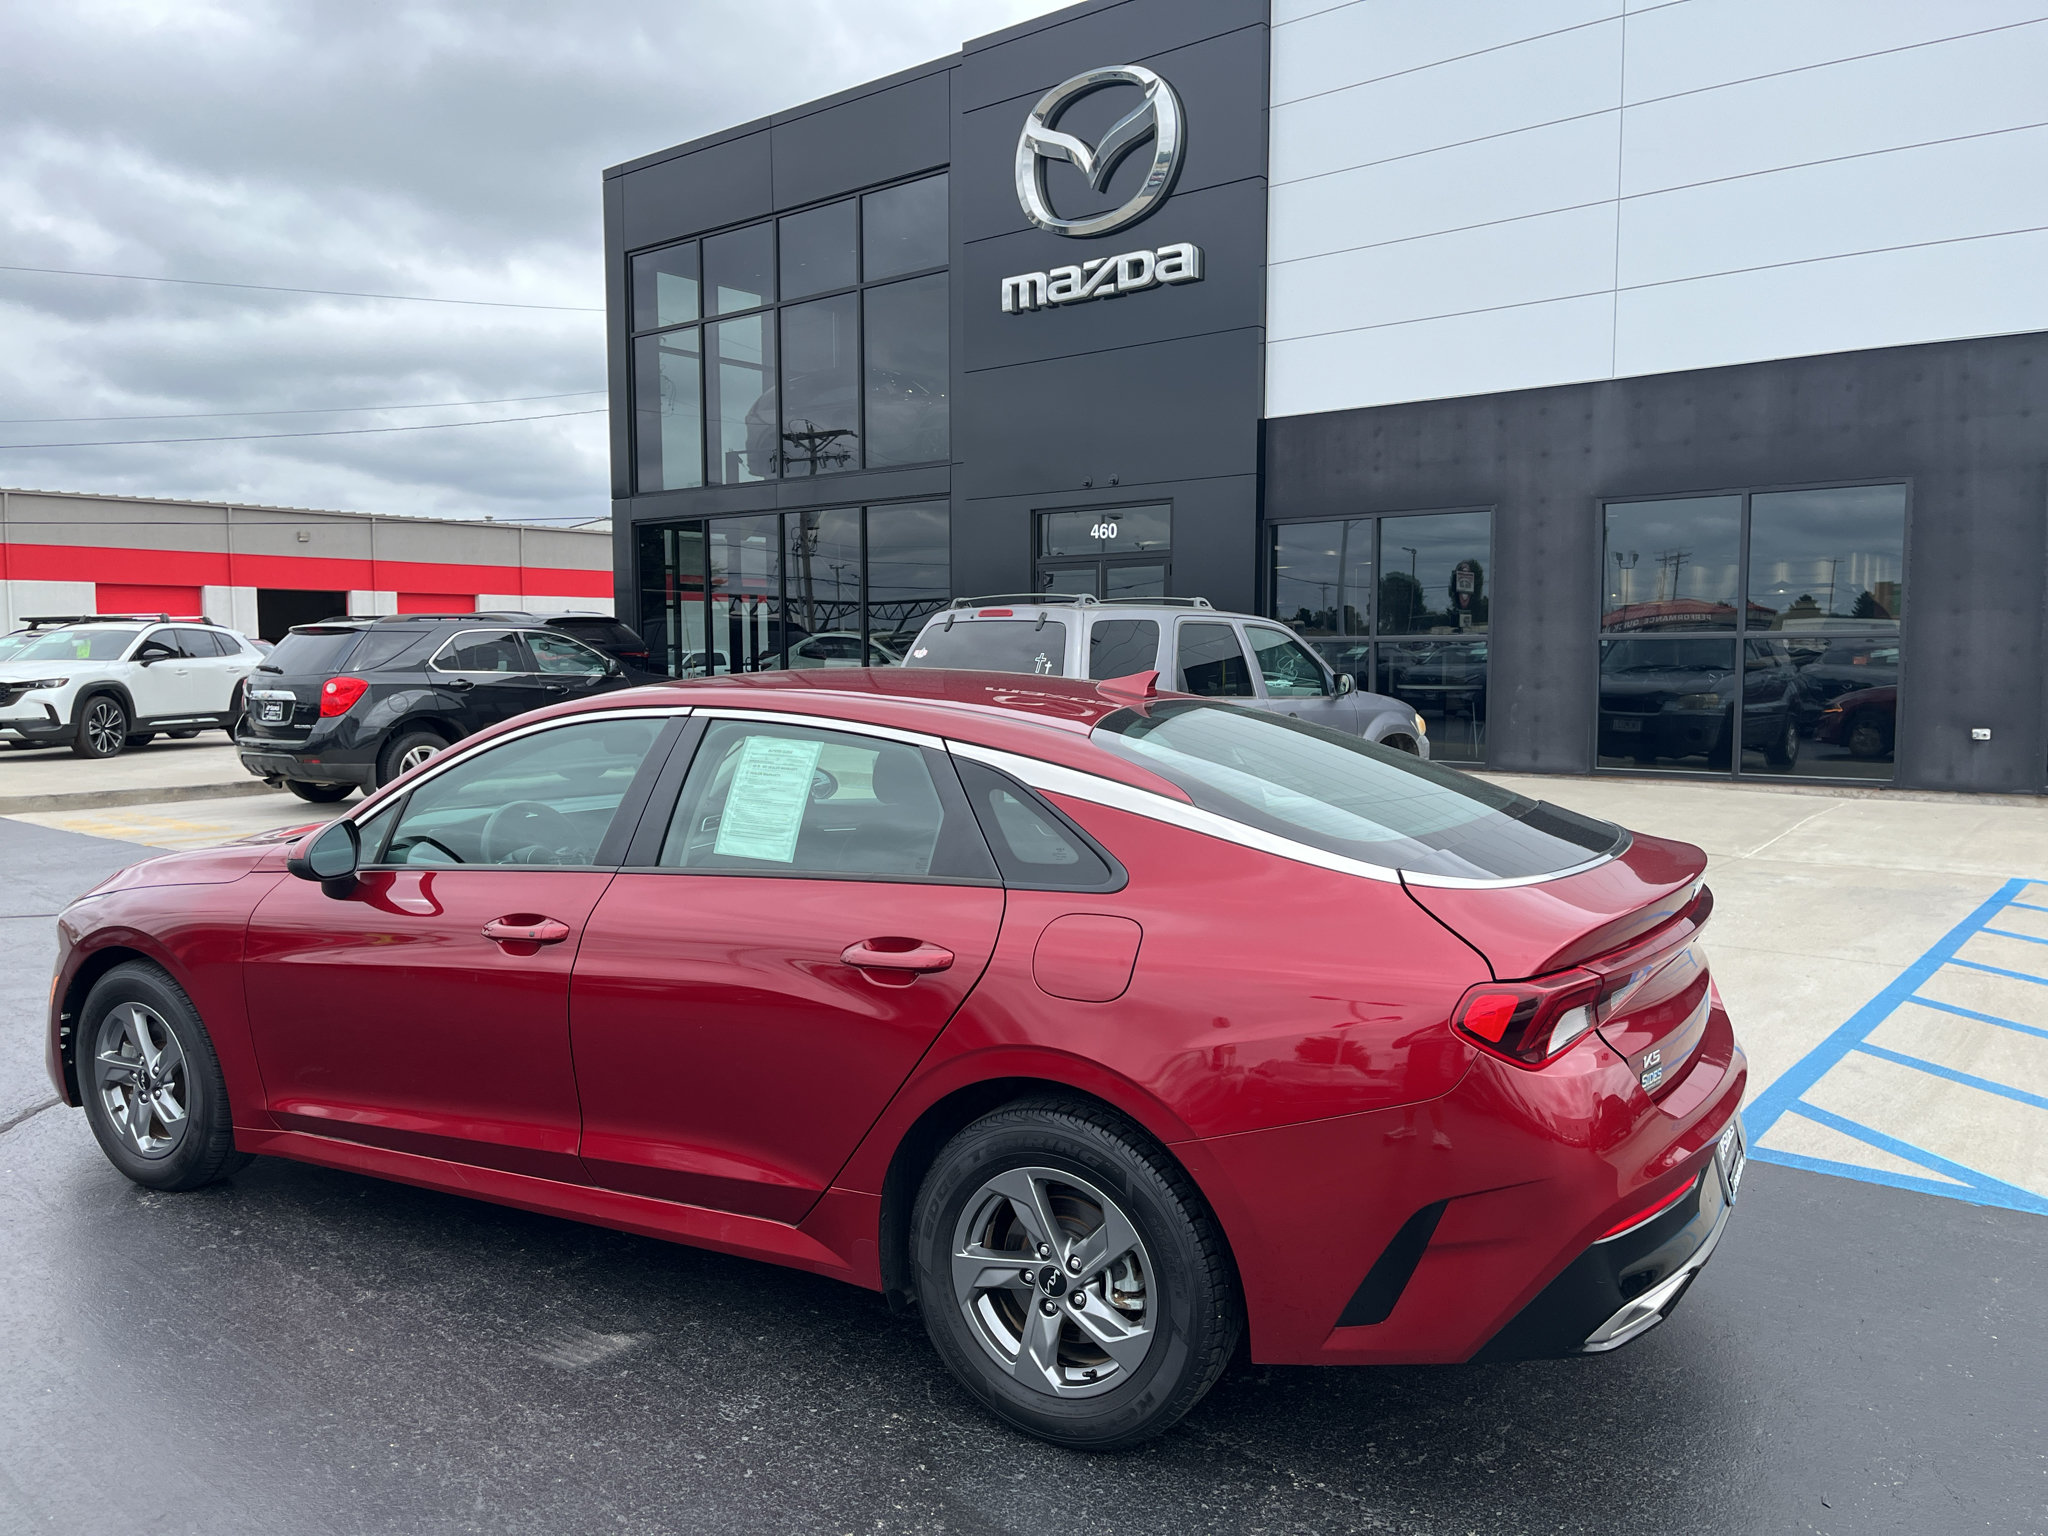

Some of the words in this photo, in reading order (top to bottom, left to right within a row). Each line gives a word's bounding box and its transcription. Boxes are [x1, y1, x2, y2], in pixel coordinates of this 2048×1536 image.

[1001, 242, 1199, 313] mazda
[1090, 522, 1117, 539] 460
[1643, 1049, 1660, 1069] K5
